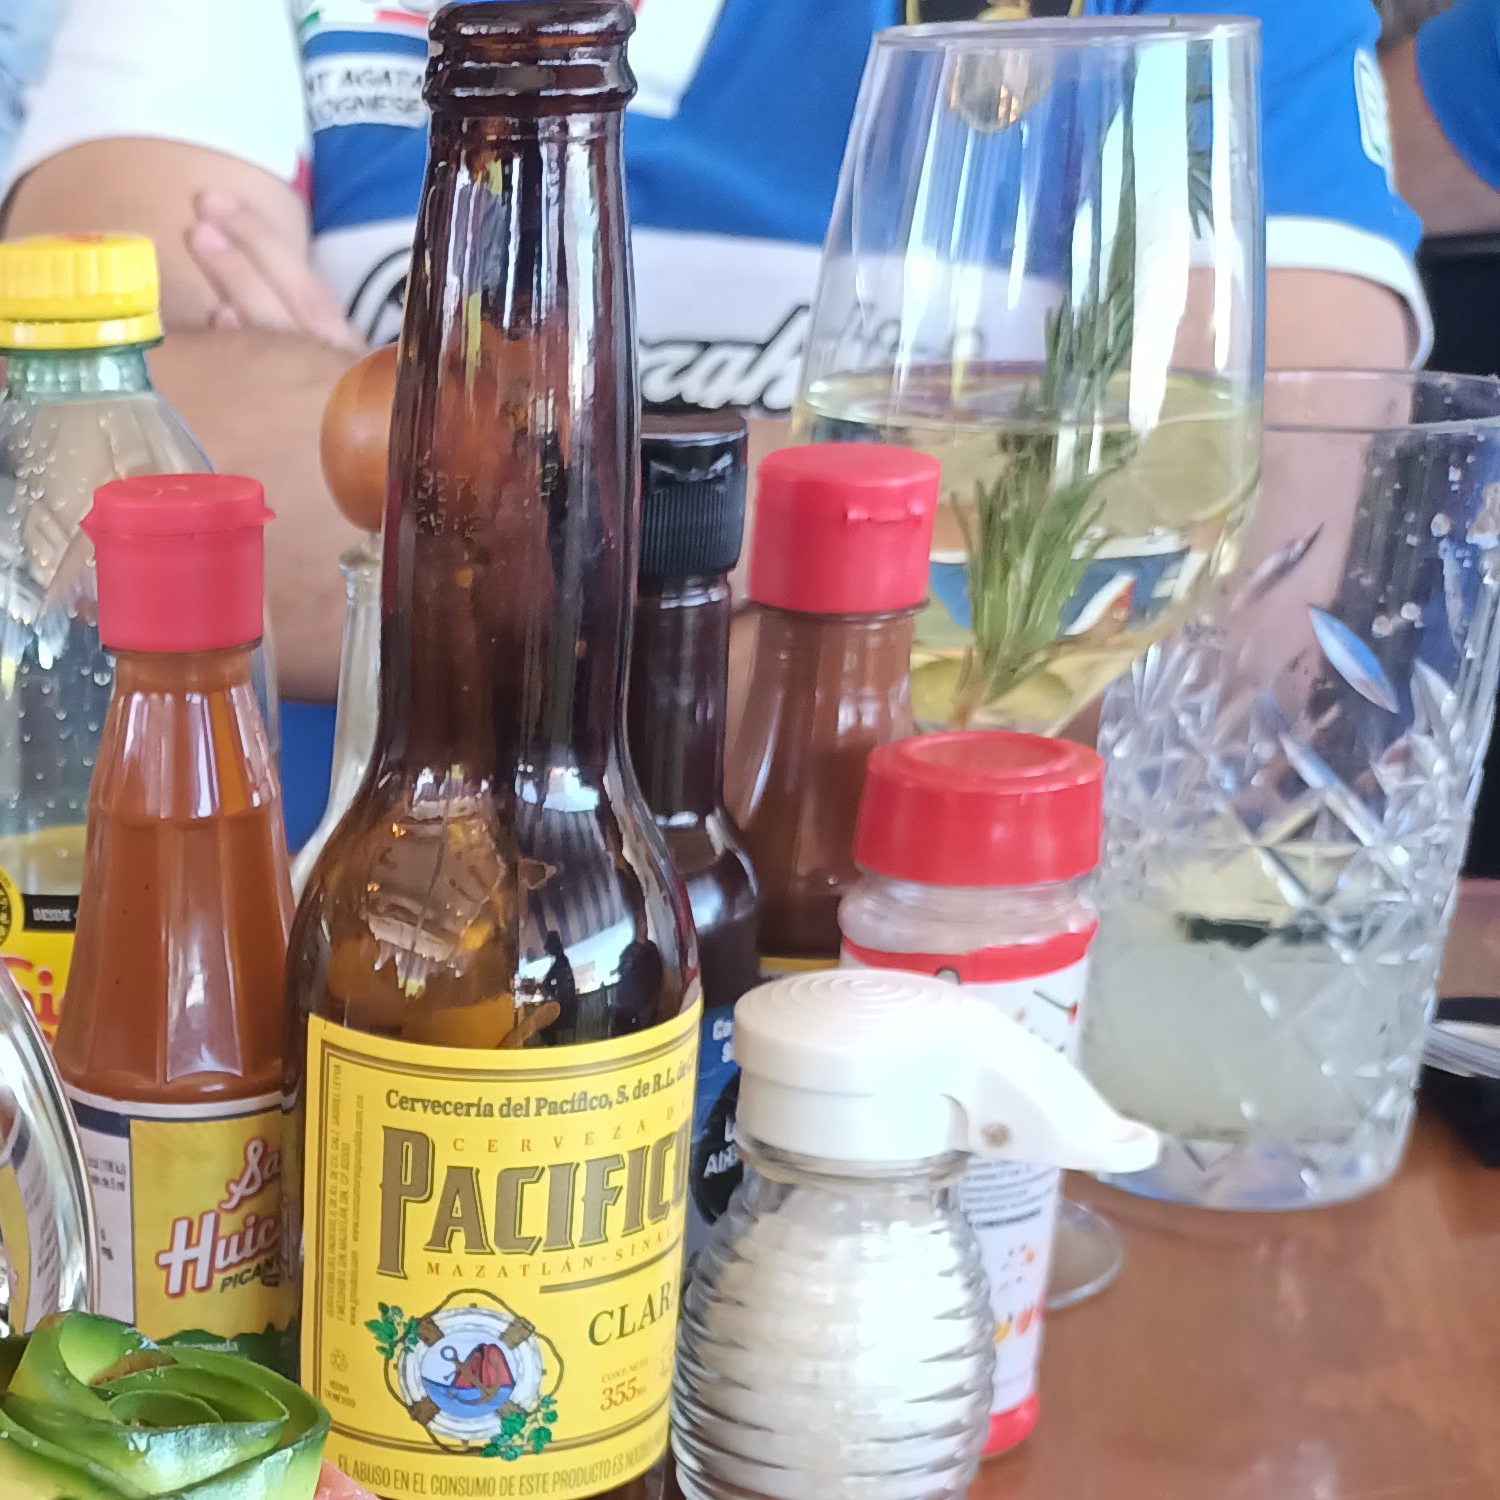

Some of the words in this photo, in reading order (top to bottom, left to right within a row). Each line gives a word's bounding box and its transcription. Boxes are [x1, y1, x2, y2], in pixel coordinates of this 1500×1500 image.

[386, 1089, 495, 1118] Cervecería
[499, 1097, 531, 1119] del
[533, 1091, 613, 1118] Pacífico,
[616, 1084, 630, 1106] S.
[632, 1079, 651, 1101] de
[651, 1067, 676, 1095] R.L.
[452, 1119, 646, 1154] CERVEZA
[426, 1254, 594, 1278] MAZATLÁN
[600, 1376, 638, 1412] 355
[352, 1465, 391, 1488] ABUSO
[394, 1469, 410, 1492] EN
[413, 1472, 427, 1494] EL
[431, 1474, 497, 1498] CONSUMO
[500, 1475, 515, 1497] DE
[519, 1472, 550, 1495] ESTE
[552, 1460, 611, 1492] PRODUCTO
[612, 1453, 625, 1477] ES
